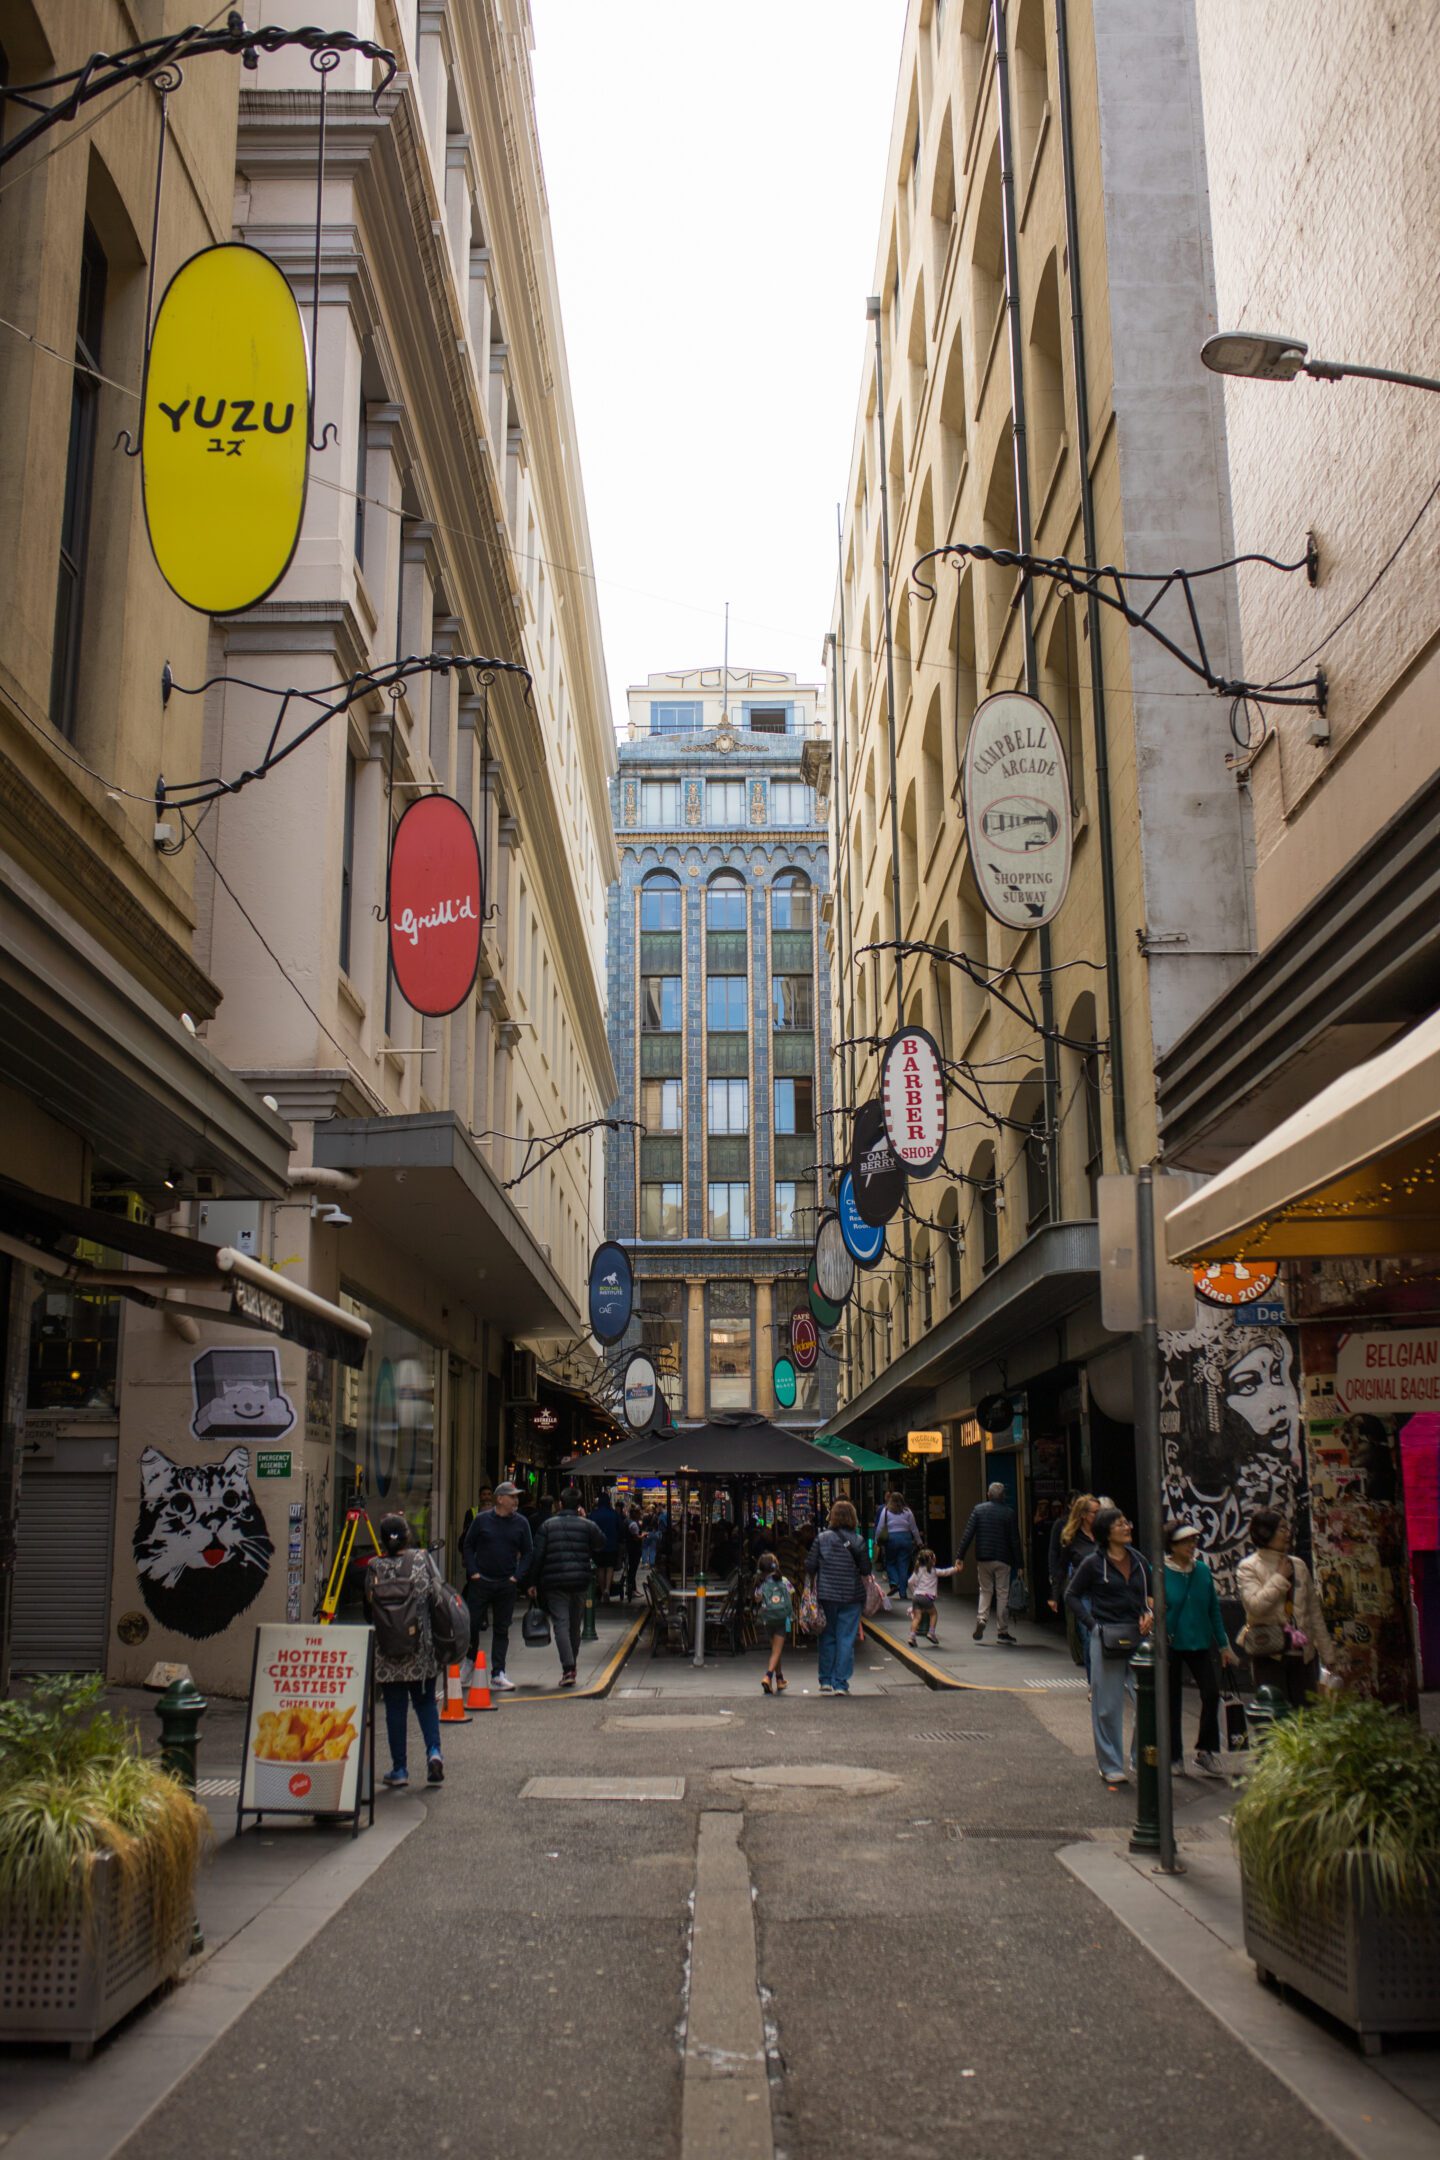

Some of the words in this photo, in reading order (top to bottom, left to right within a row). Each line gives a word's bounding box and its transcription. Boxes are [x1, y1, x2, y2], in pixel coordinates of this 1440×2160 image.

[158, 396, 294, 434] YUZU
[207, 438, 246, 457] ユズ
[973, 727, 1047, 775] CAMPBELL
[1001, 758, 1059, 779] ARCADE
[994, 872, 1053, 884] SHOPPING
[1003, 891, 1048, 903] SUBWAY
[393, 895, 478, 946] Grill'd
[902, 1040, 926, 1140] BARBER
[867, 1150, 889, 1161] OAK
[901, 1146, 934, 1159] SHOP
[860, 1157, 896, 1171] BERRY
[1197, 1277, 1233, 1303] Since
[1238, 1274, 1271, 1302] 2003
[1365, 1340, 1438, 1368] BELGIAN
[1345, 1378, 1397, 1401] ORIGINAL
[1401, 1377, 1440, 1401] BAGUE
[260, 1461, 288, 1469] ASSEMBLY
[305, 1637, 322, 1646] THE
[277, 1650, 348, 1664] HOTTEST
[268, 1665, 354, 1679] CRISPIEST
[273, 1680, 347, 1694] TASTIEST
[279, 1699, 309, 1709] CHIPS
[311, 1699, 336, 1709] EVER
